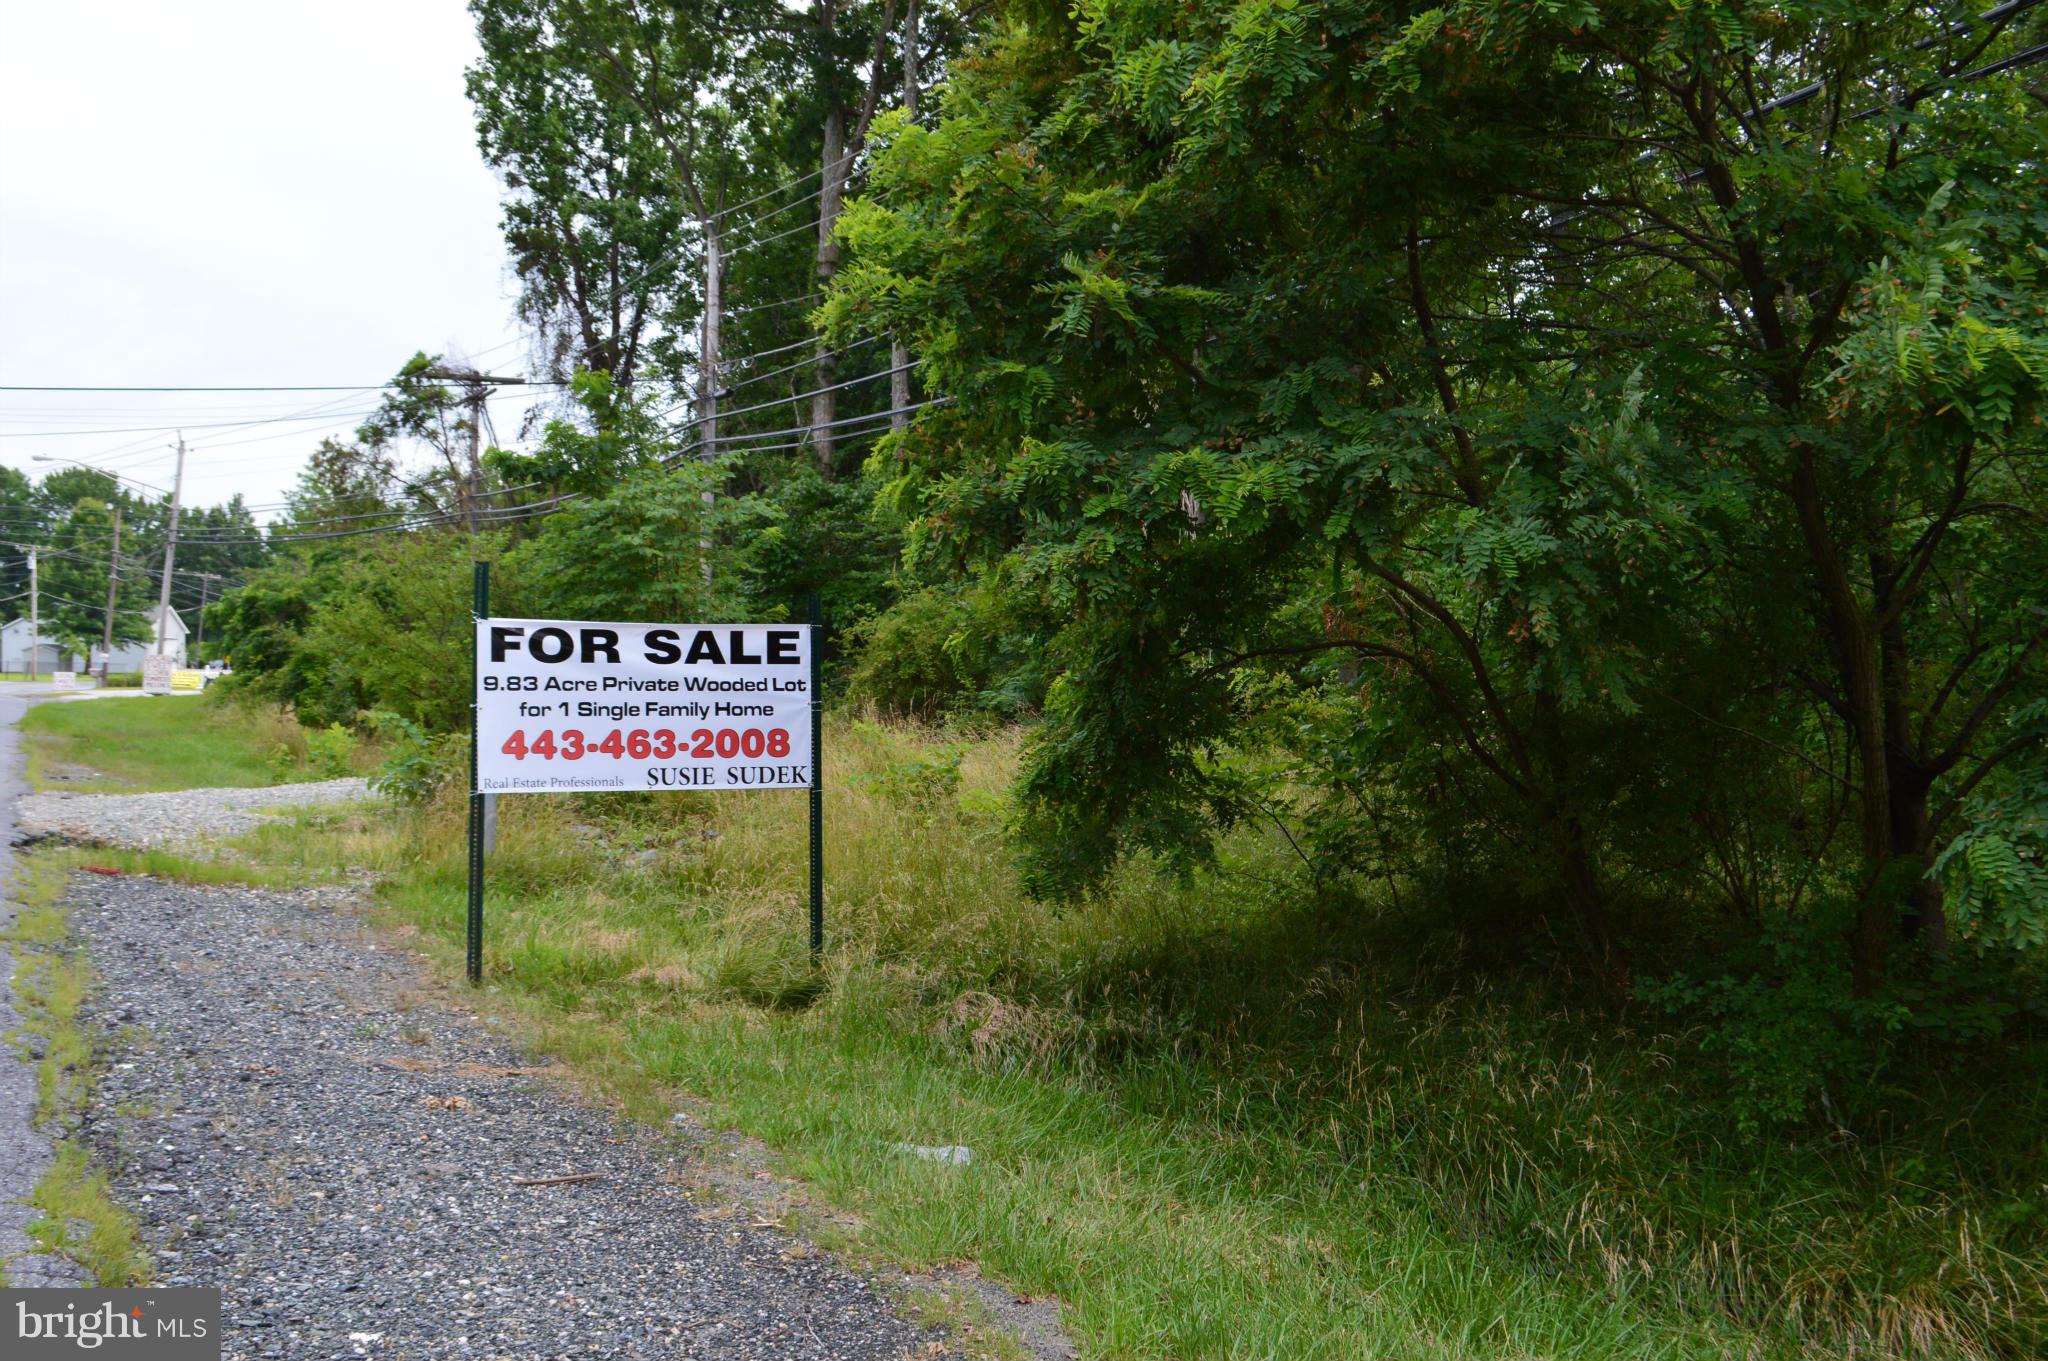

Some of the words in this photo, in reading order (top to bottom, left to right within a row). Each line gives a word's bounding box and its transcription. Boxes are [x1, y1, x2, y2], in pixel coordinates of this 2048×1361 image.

[491, 627, 621, 663] FOR
[644, 629, 801, 664] SALE
[484, 676, 538, 691] 9.83
[544, 676, 597, 691] Acre
[603, 676, 679, 692] Private
[685, 677, 768, 692] Wooded
[773, 677, 806, 692] Lot
[520, 702, 551, 717] for
[559, 702, 569, 717] 1
[578, 702, 640, 720] Single
[646, 702, 709, 720] Family
[715, 702, 774, 717] Home
[502, 728, 790, 760] 443-463-2008
[484, 777, 510, 789] Real
[513, 777, 547, 788] Estate
[551, 776, 624, 788] Professionals
[647, 767, 715, 786] SUSIE
[727, 765, 807, 785] SUDEK
